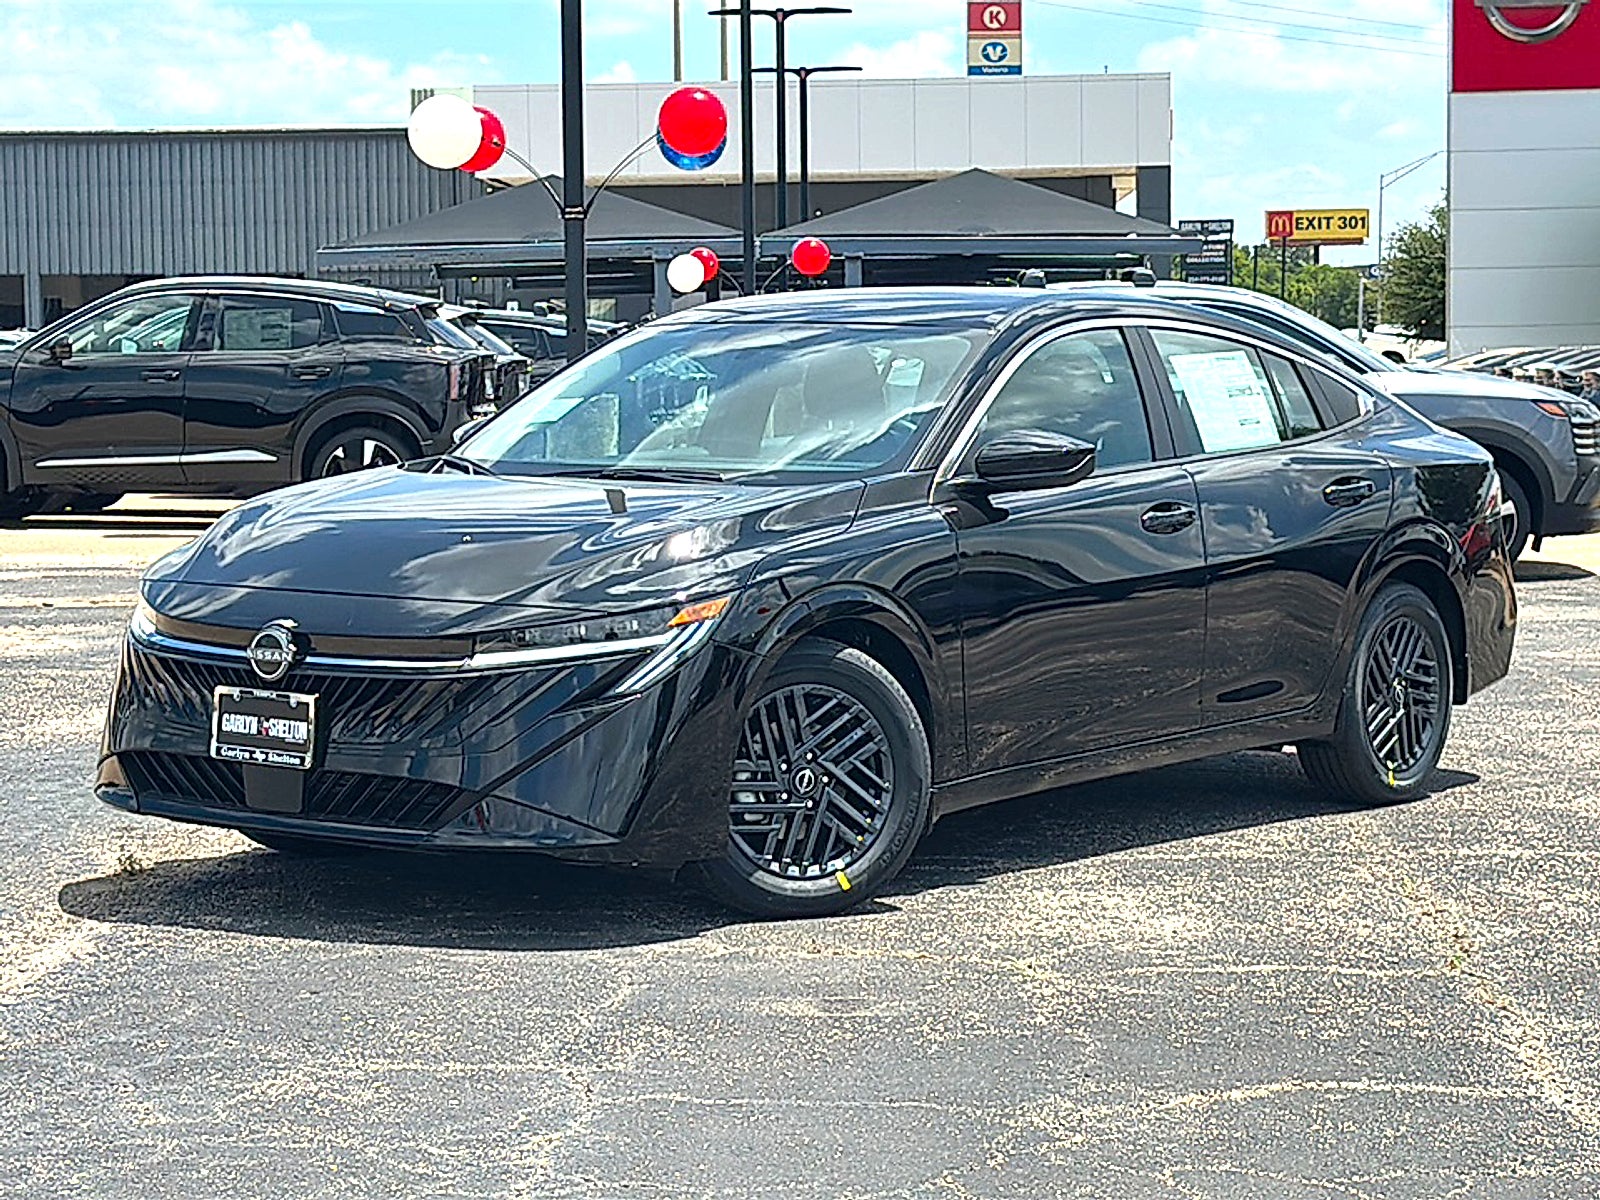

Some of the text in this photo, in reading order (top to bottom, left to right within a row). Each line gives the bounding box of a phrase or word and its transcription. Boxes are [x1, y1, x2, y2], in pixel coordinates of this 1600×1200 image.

[988, 9, 1003, 27] K
[1295, 215, 1366, 231] EXIT 301
[247, 648, 293, 663] NISSAN
[221, 713, 308, 740] GARLYN SHELTON
